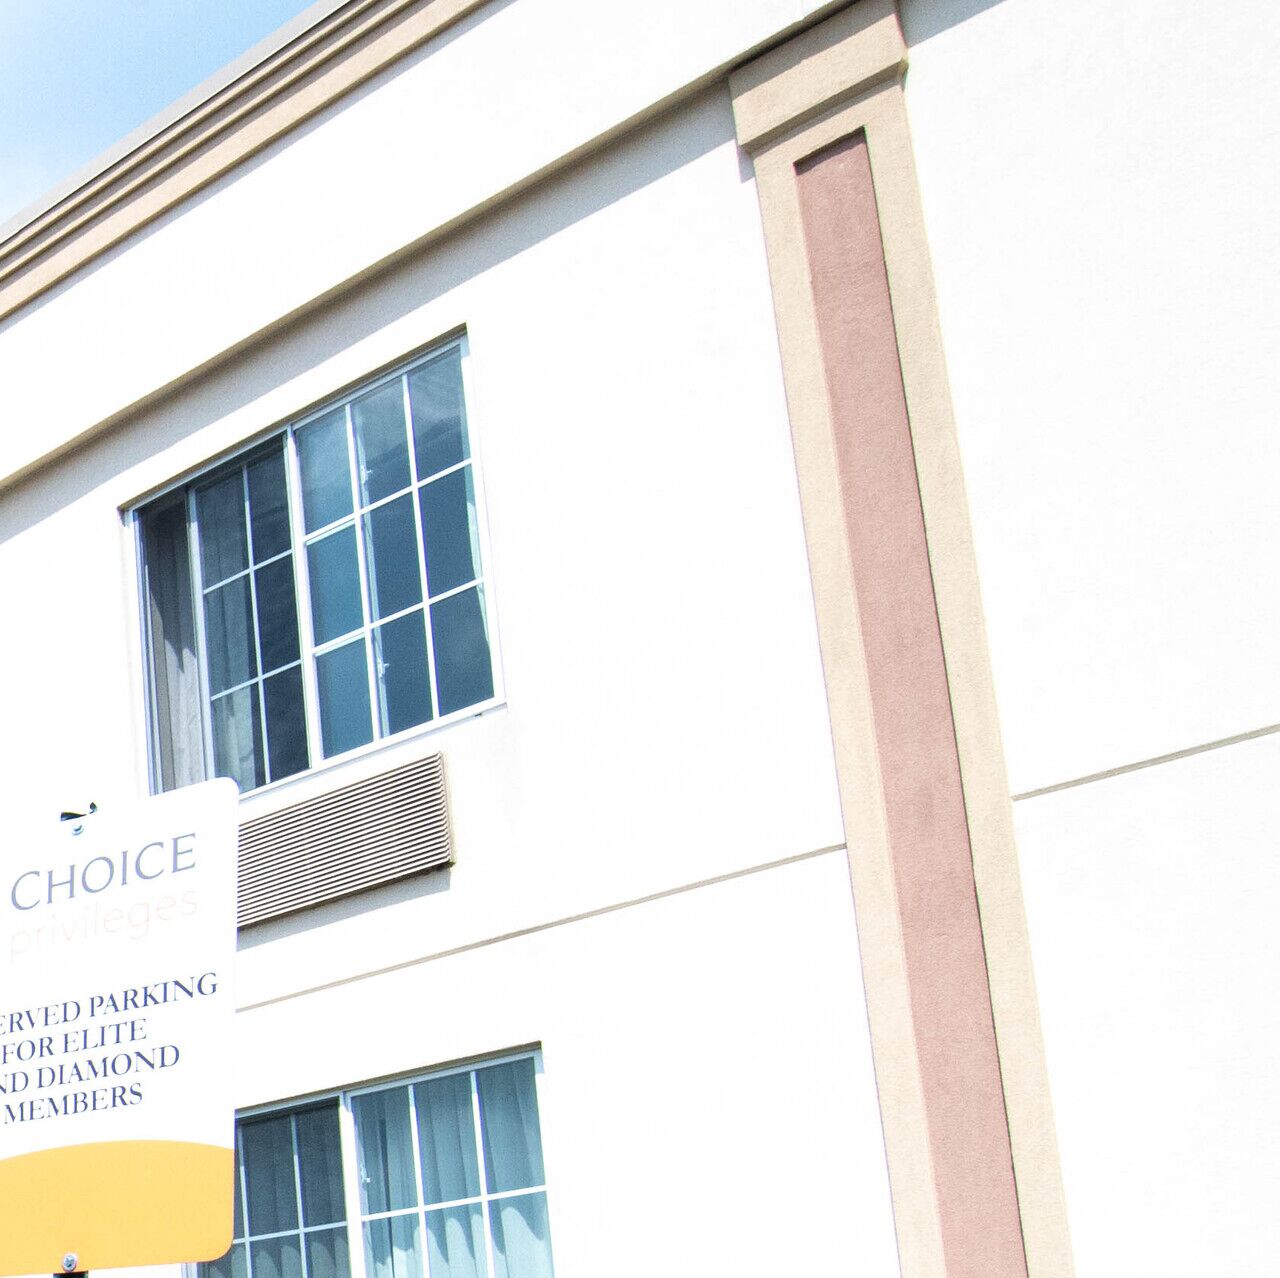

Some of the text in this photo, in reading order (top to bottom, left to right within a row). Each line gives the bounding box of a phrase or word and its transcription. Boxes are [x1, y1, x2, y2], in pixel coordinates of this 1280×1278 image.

[10, 832, 198, 911] CHOICE
[10, 889, 199, 965] privileges
[89, 972, 219, 1018] PARKING
[1, 1018, 148, 1065] FOR ELITE
[37, 1044, 181, 1090] DIAMOND
[3, 1083, 144, 1125] MEMBERS
